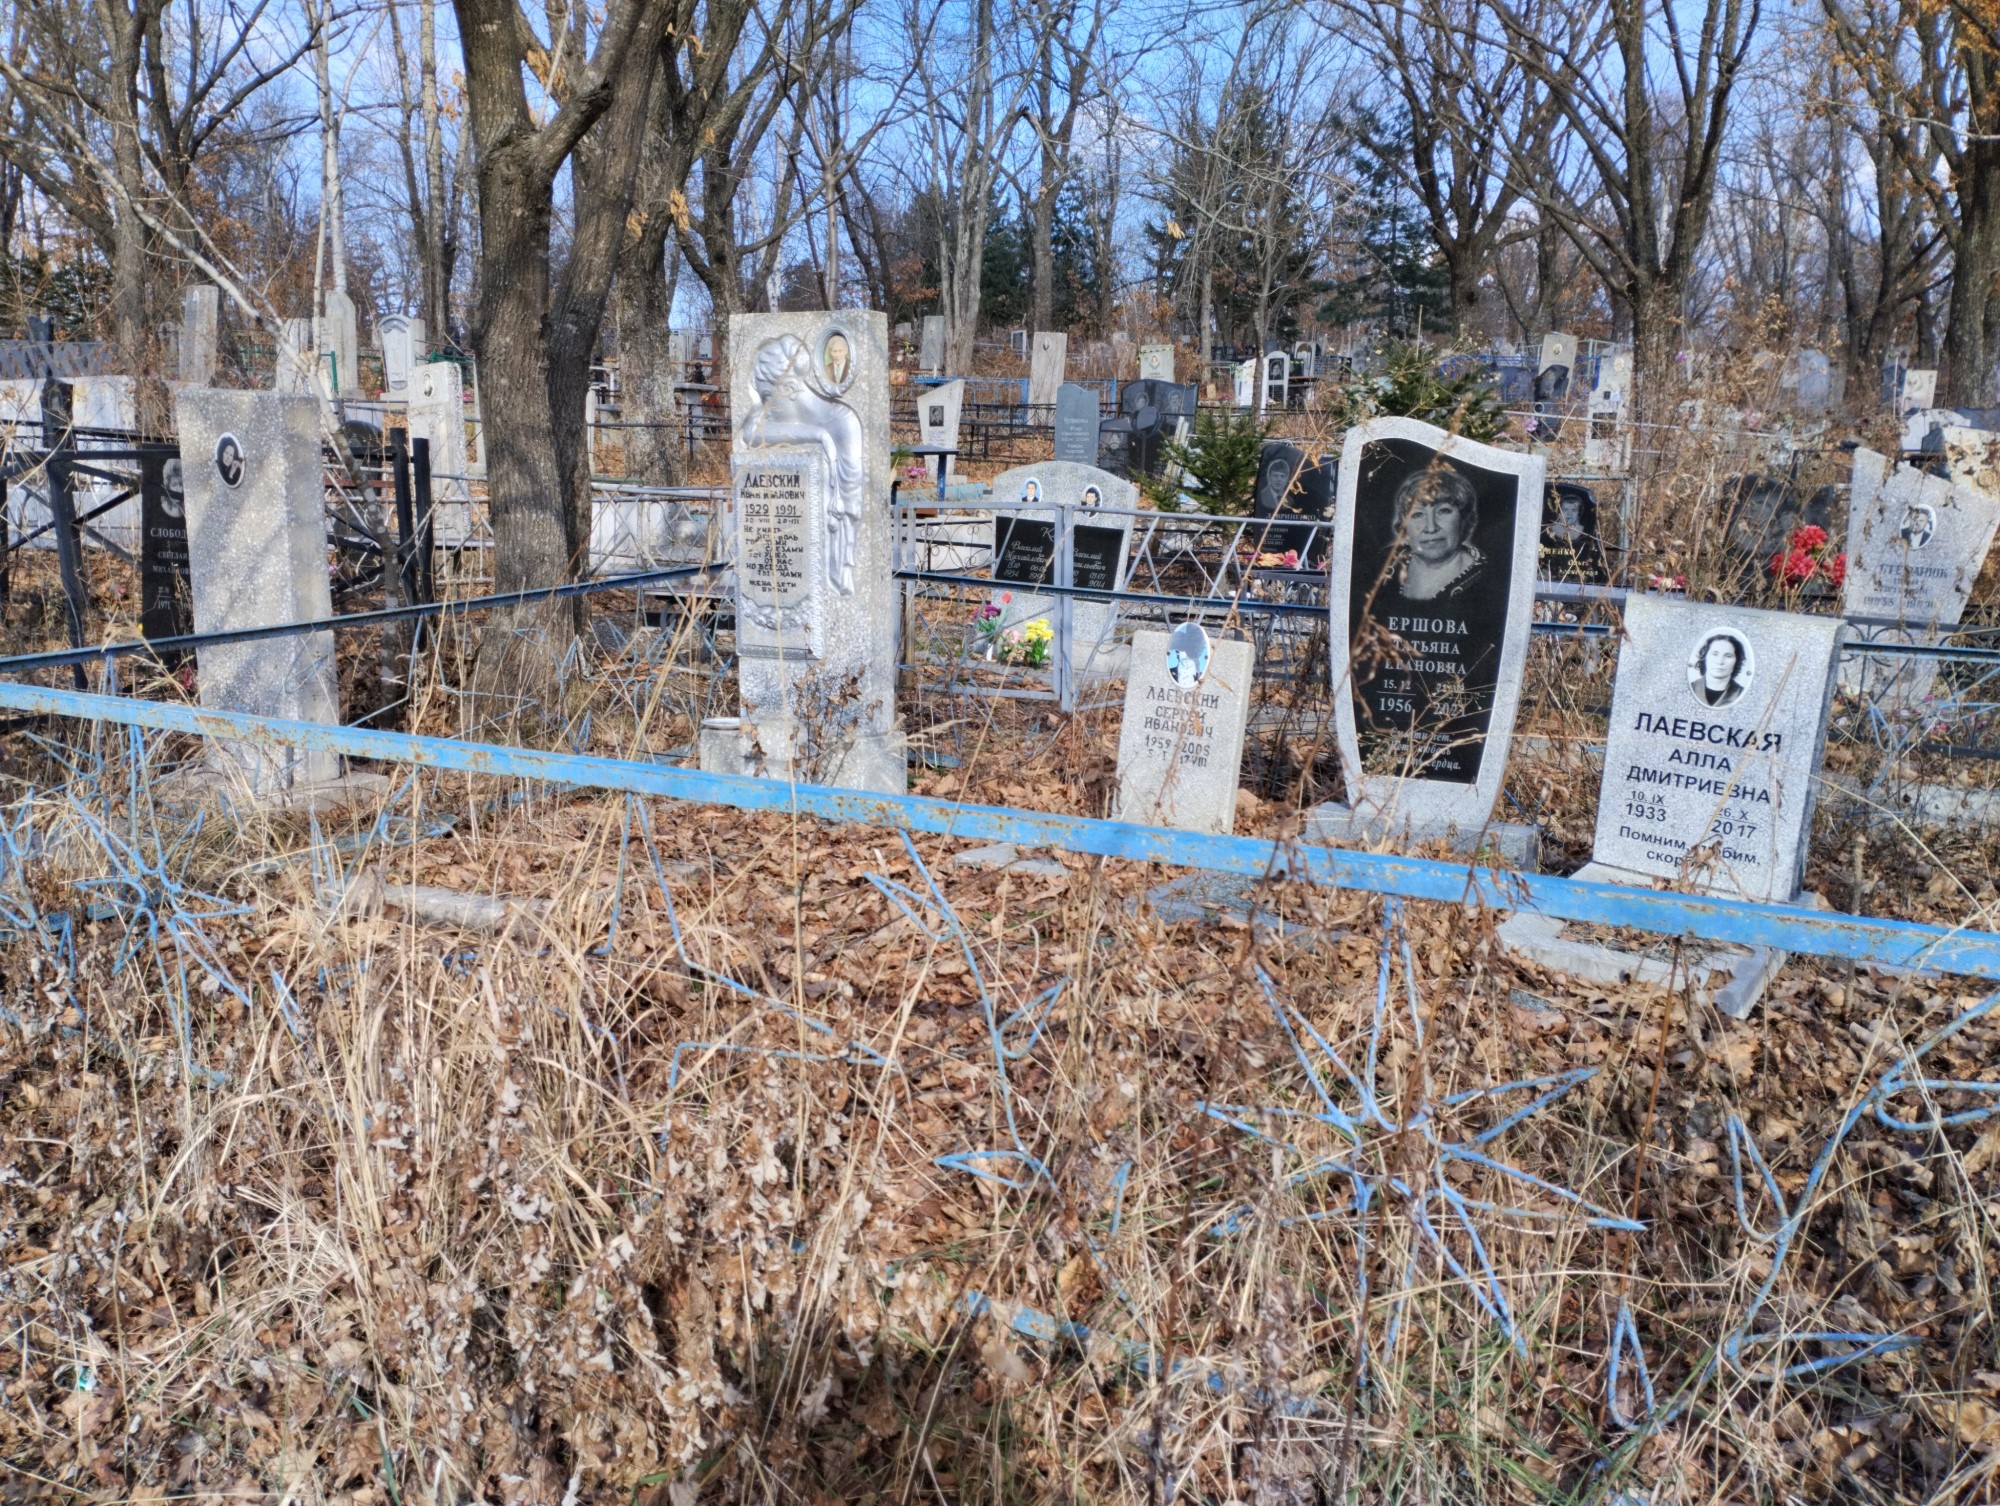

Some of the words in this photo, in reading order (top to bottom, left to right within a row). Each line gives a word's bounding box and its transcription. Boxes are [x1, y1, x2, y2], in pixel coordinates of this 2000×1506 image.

[744, 470, 800, 488] ЛАЕВСКИЙ
[745, 503, 769, 514] 1929
[775, 504, 797, 515] 1991
[757, 563, 789, 572] ВСЕДА
[1388, 616, 1469, 635] ЕРШОВА
[1393, 639, 1460, 655] ТТЬЯНА
[1379, 698, 1413, 712] 1956
[1634, 712, 1782, 753] ЛАЕВСКАЯ
[1668, 749, 1732, 773] АЛЛА
[1626, 765, 1771, 804] ДМИТРИЕВНА
[1625, 803, 1667, 822] 1933
[1701, 844, 1761, 867] бим,
